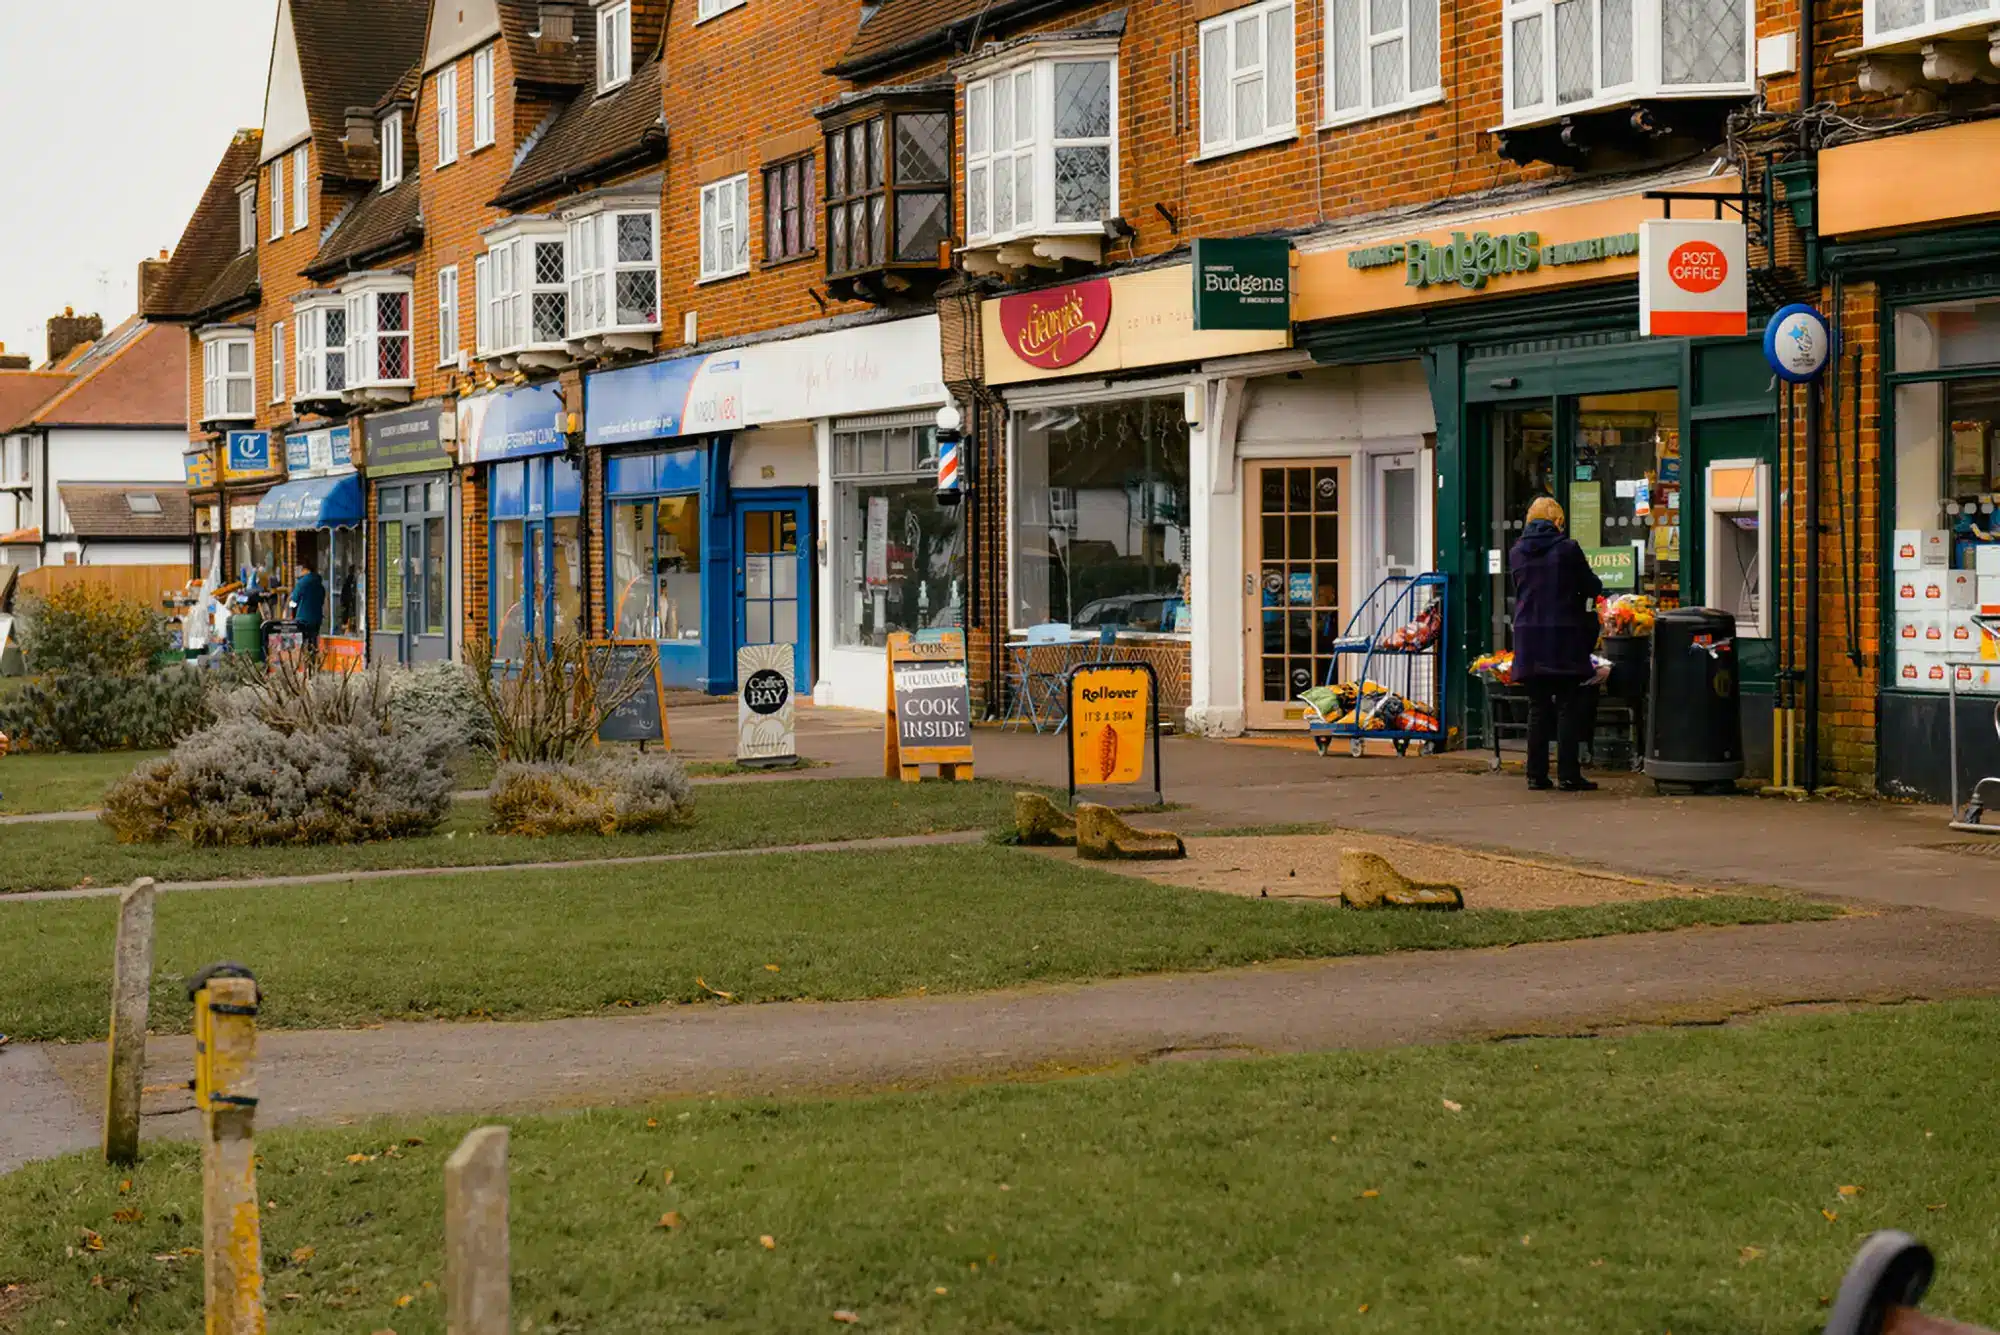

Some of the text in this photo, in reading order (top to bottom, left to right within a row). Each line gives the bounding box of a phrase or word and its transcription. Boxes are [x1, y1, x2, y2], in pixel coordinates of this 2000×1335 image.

[1405, 231, 1540, 289] Budgens
[1682, 251, 1716, 265] POST
[1673, 266, 1721, 280] OFFICE
[1204, 273, 1285, 295] Budgens
[912, 643, 948, 656] COOK
[749, 676, 785, 690] Coffee
[749, 689, 786, 706] BAY
[1082, 686, 1139, 703] Rollover
[904, 697, 961, 716] COOK
[1113, 710, 1134, 722] SIGN
[903, 720, 966, 738] INSIDE
